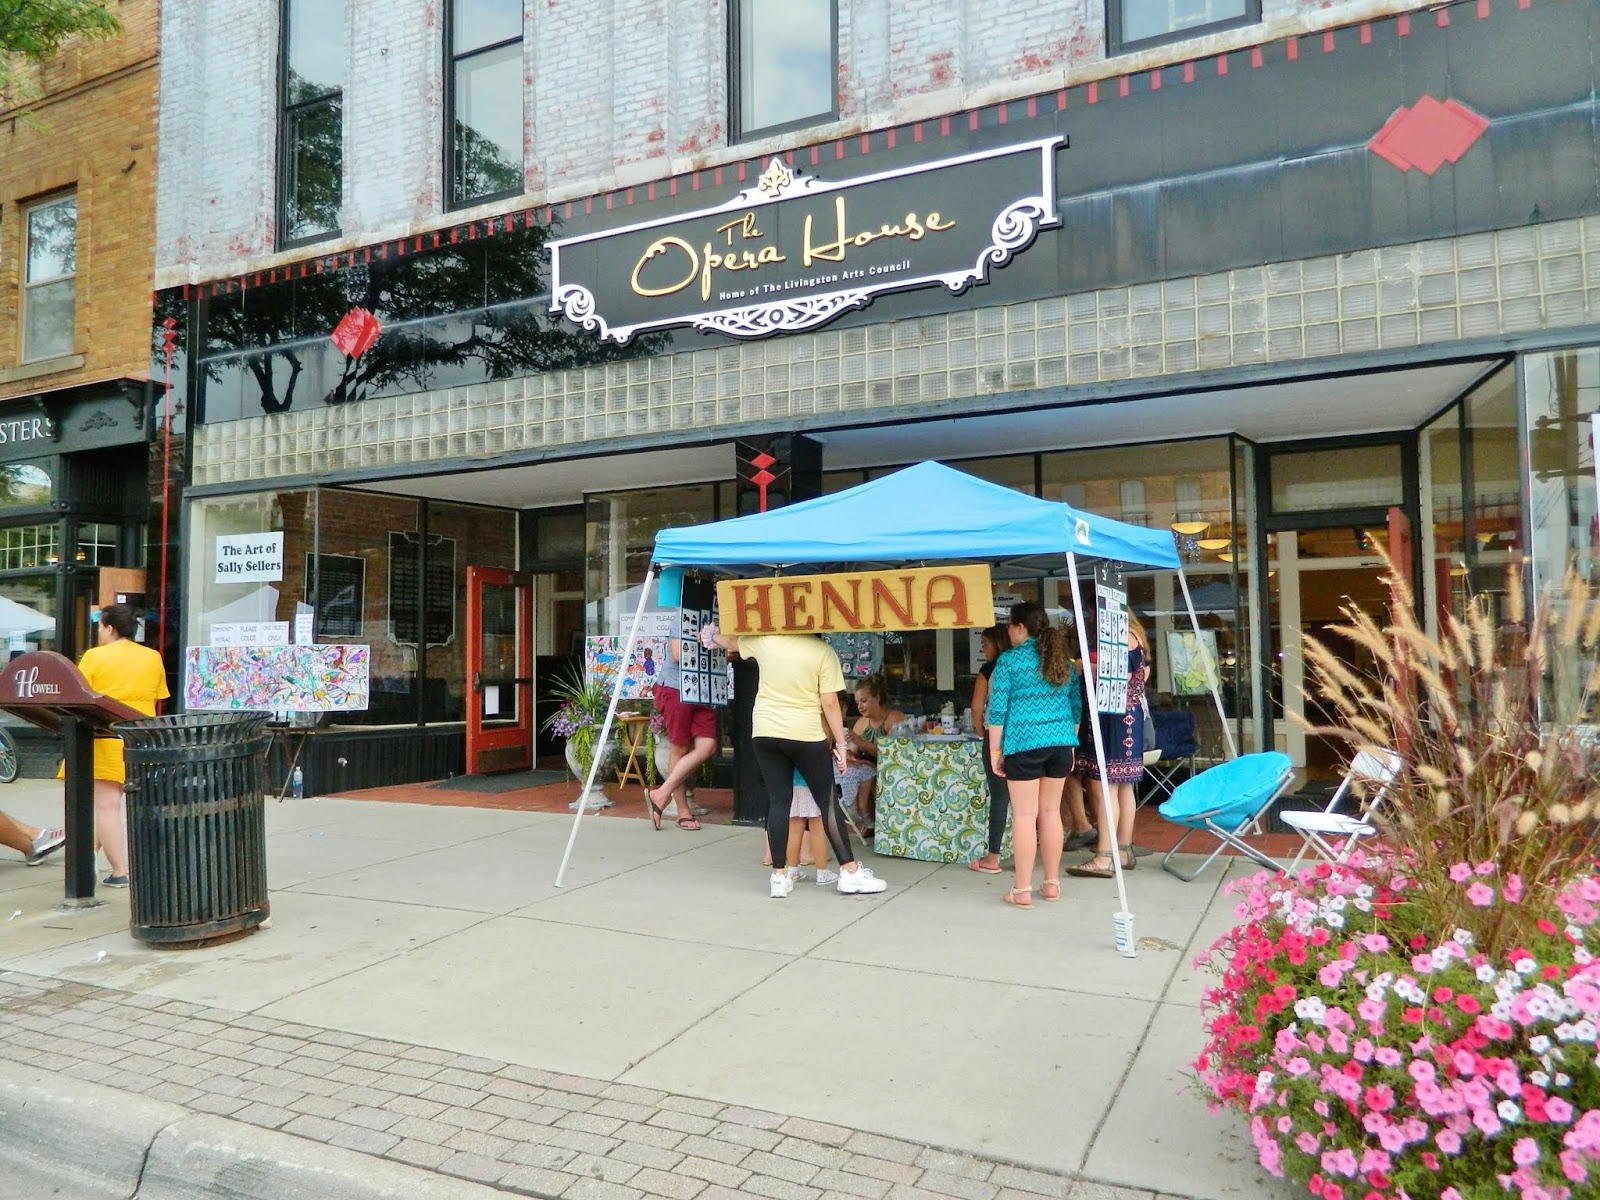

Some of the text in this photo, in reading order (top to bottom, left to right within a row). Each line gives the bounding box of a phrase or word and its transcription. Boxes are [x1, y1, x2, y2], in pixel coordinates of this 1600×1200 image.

[716, 212, 763, 245] The
[630, 196, 956, 302] Opera House
[719, 260, 911, 301] Home of The Livingston Arts Council
[217, 560, 281, 574] Sally Sellers
[222, 542, 277, 556] The Art of
[730, 574, 974, 632] HENNA
